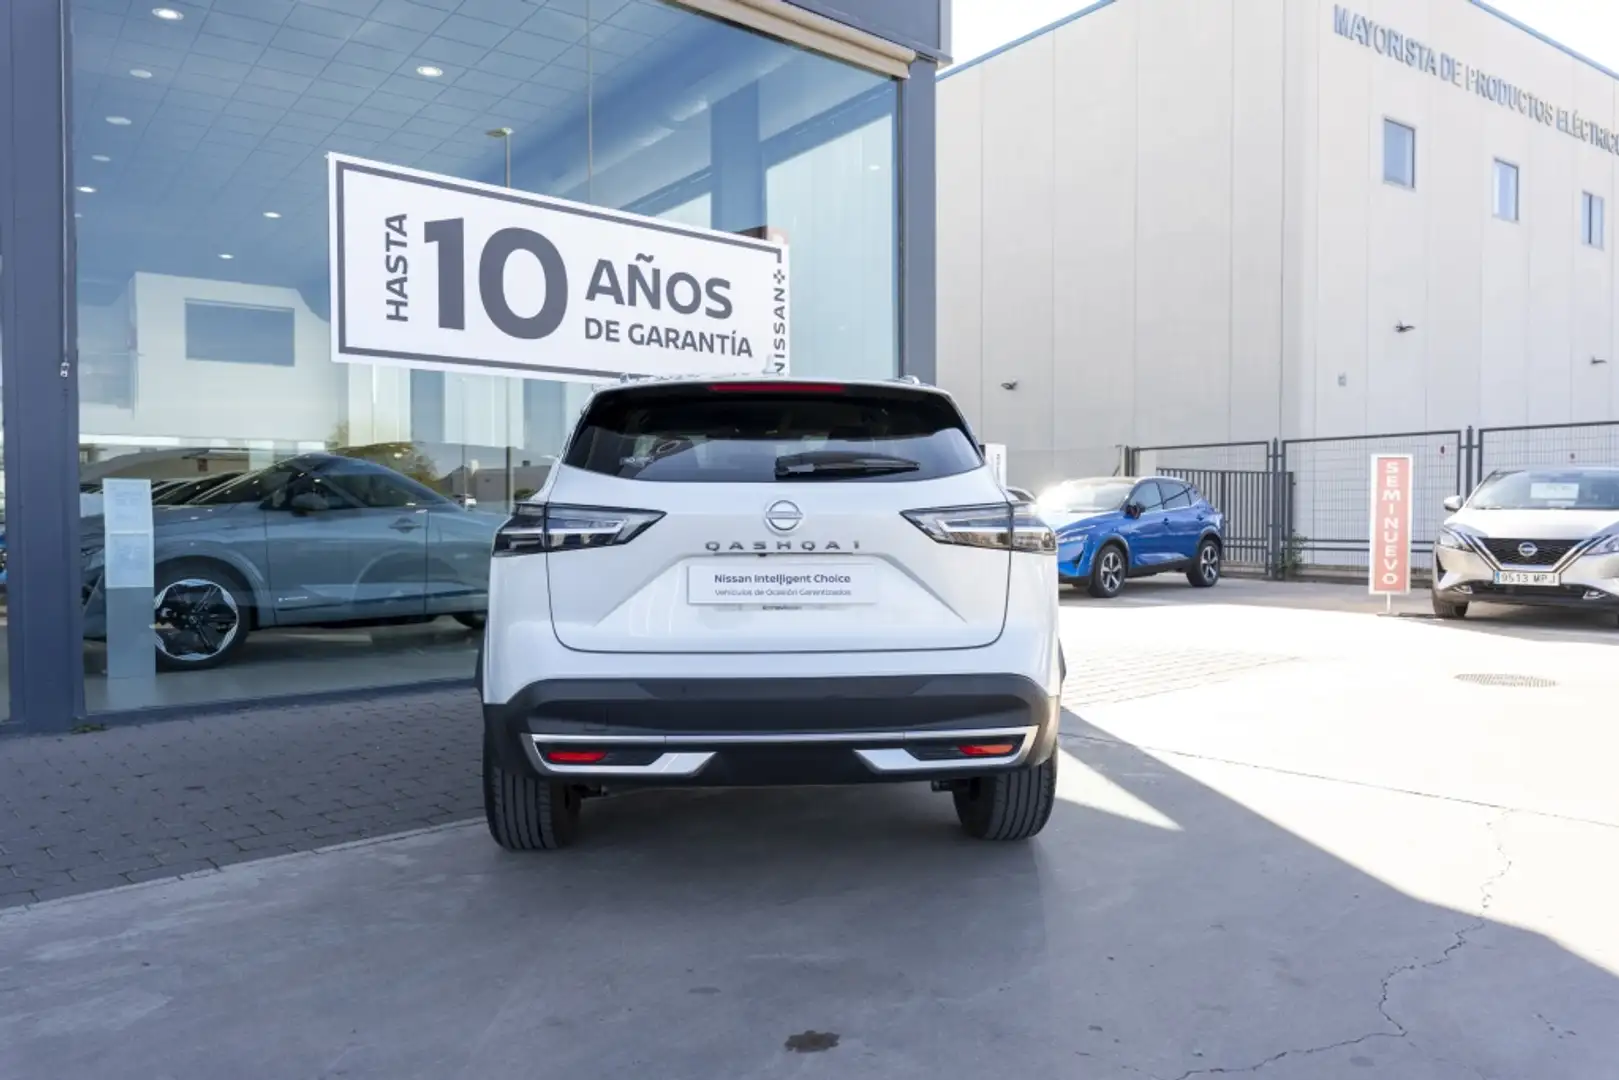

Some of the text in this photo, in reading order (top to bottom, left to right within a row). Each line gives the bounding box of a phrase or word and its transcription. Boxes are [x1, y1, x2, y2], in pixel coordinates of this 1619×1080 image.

[1333, 3, 1437, 76] MAYORISTA
[1439, 52, 1463, 88] DE
[1465, 65, 1554, 127] PRODUCTOS
[385, 213, 408, 322] HASTA
[423, 216, 569, 340] 10
[585, 253, 733, 319] AÑOS
[585, 318, 753, 358] DE GARANTÍA
[773, 287, 786, 376] NISSAN
[704, 540, 861, 552] QASHQAI
[1381, 461, 1401, 585] SEMINUEVO
[714, 574, 752, 584] Nissan
[813, 574, 851, 584] Choice
